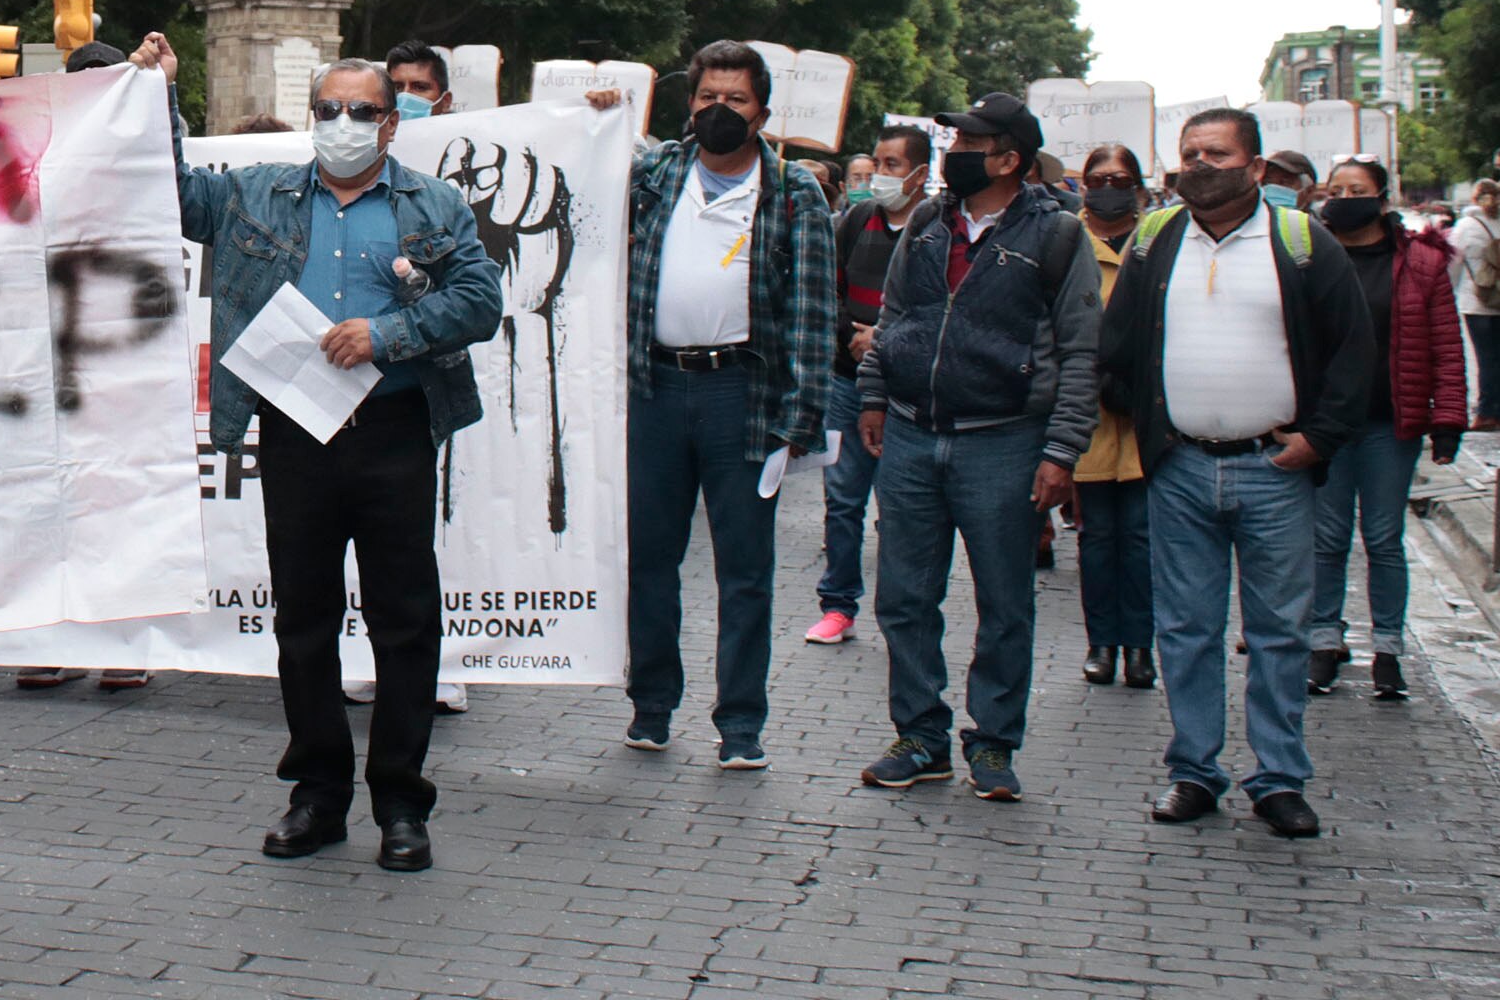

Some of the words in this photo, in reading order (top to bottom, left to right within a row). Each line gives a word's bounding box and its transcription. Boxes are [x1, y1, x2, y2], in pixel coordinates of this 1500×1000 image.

[444, 592, 473, 611] UE
[481, 592, 505, 611] SE
[514, 590, 598, 611] PIERDE
[239, 615, 264, 634] ES
[462, 654, 493, 669] CHE
[498, 655, 572, 669] GUEVARA
